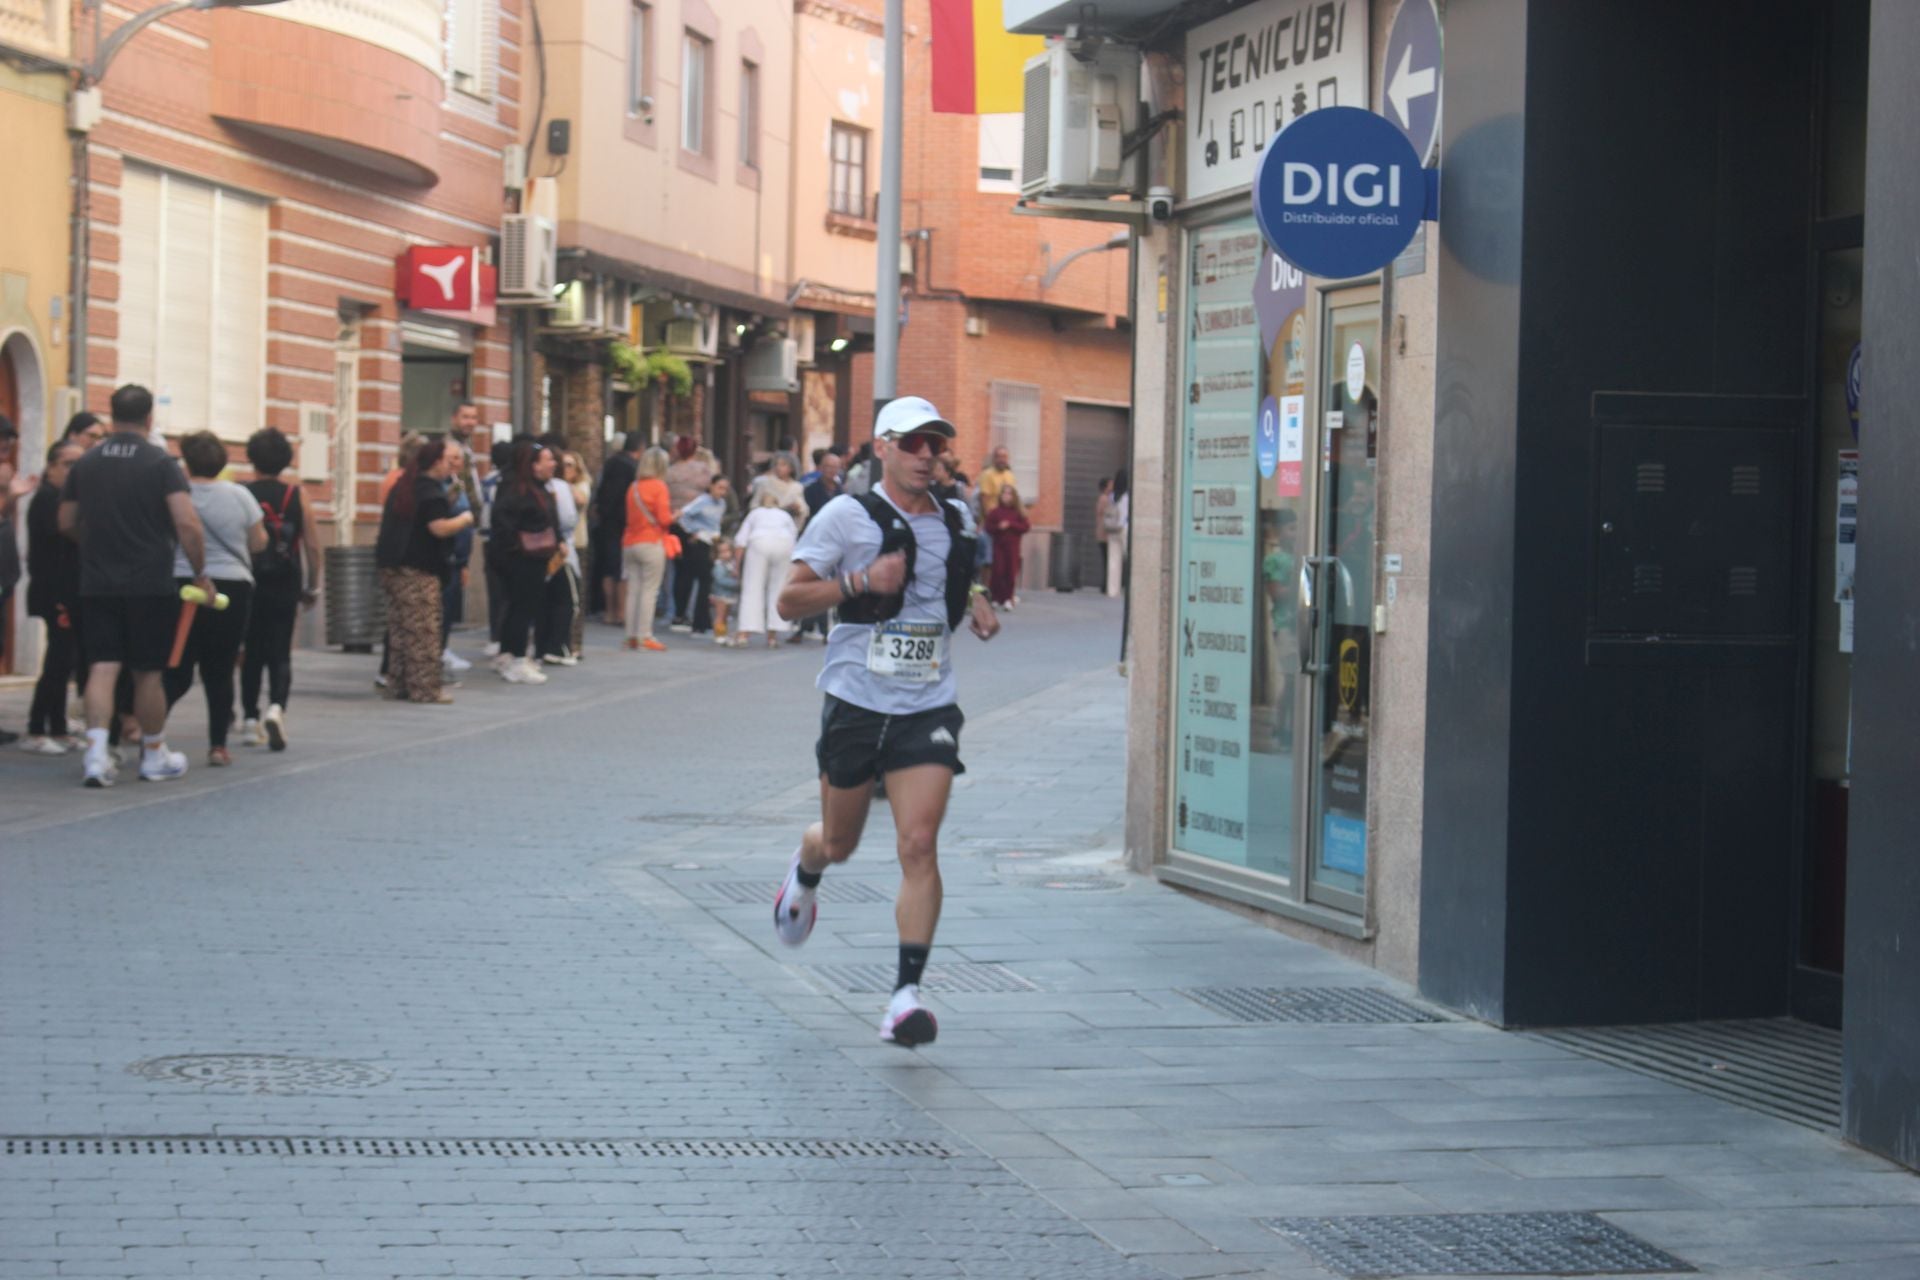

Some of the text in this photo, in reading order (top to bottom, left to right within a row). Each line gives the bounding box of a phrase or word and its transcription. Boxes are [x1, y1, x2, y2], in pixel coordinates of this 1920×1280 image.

[1198, 1, 1346, 138] TECNICUBI
[1283, 162, 1400, 207] DIGI
[1283, 211, 1399, 225] Distribuidor oficial
[890, 638, 935, 660] 3289
